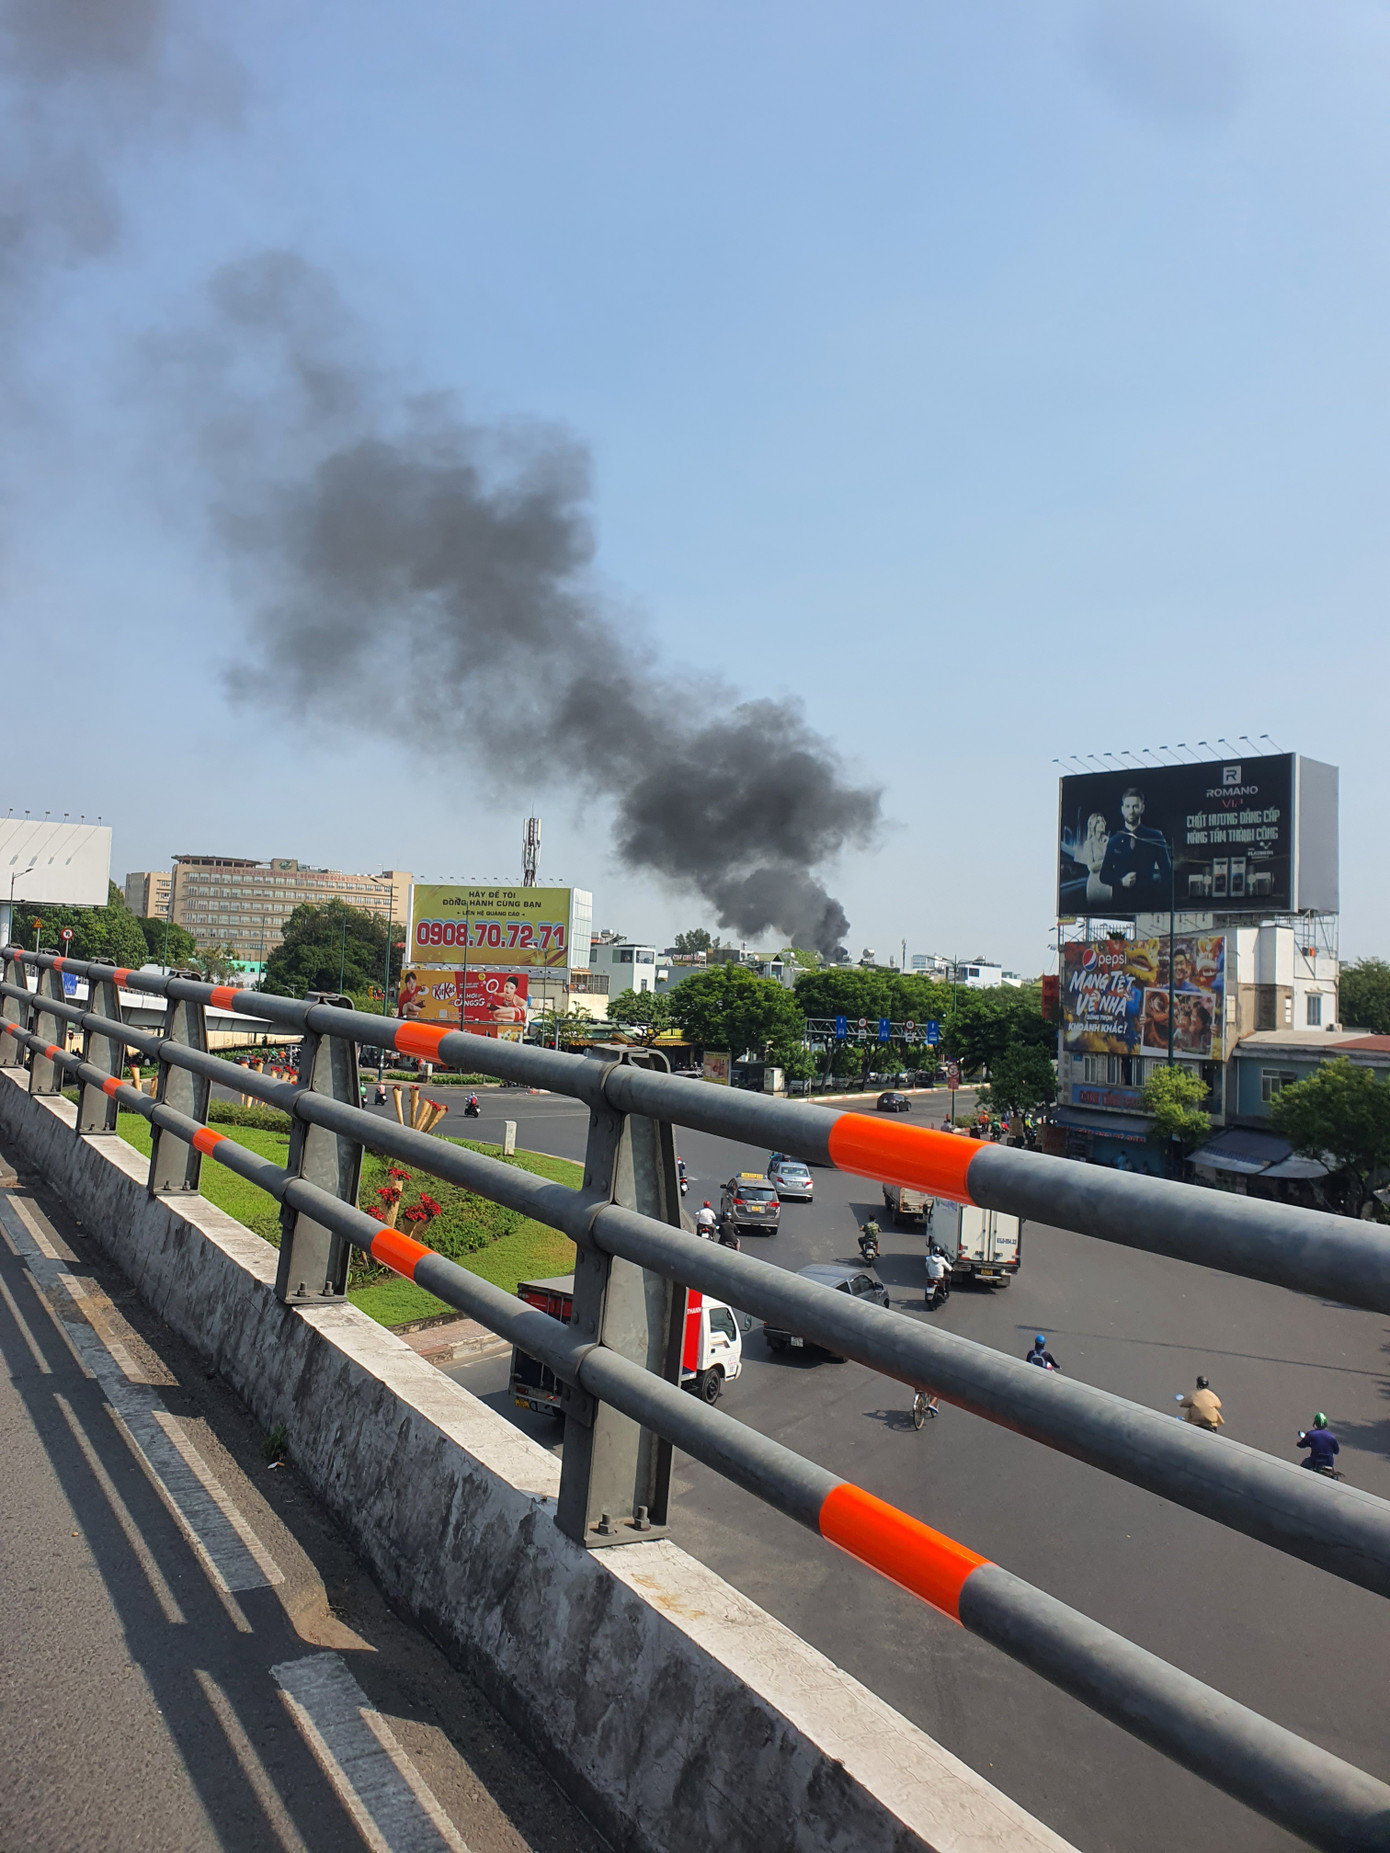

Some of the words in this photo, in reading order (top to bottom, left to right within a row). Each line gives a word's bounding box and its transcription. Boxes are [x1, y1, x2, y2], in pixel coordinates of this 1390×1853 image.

[1206, 785, 1259, 798] ROMANO
[1222, 798, 1243, 808] VIP
[503, 891, 516, 899] TÔI
[469, 899, 493, 907] HÀNH
[496, 899, 520, 907] CÙNG
[523, 901, 542, 909] BẠN
[416, 921, 566, 950] 0908.70.72.71
[1098, 952, 1127, 968] pepsi
[1069, 970, 1110, 993] MANG
[1110, 970, 1136, 994] TẾT
[433, 982, 456, 1000] KitKat
[1076, 990, 1100, 1017] VỀ
[1099, 993, 1131, 1017] NHÀ
